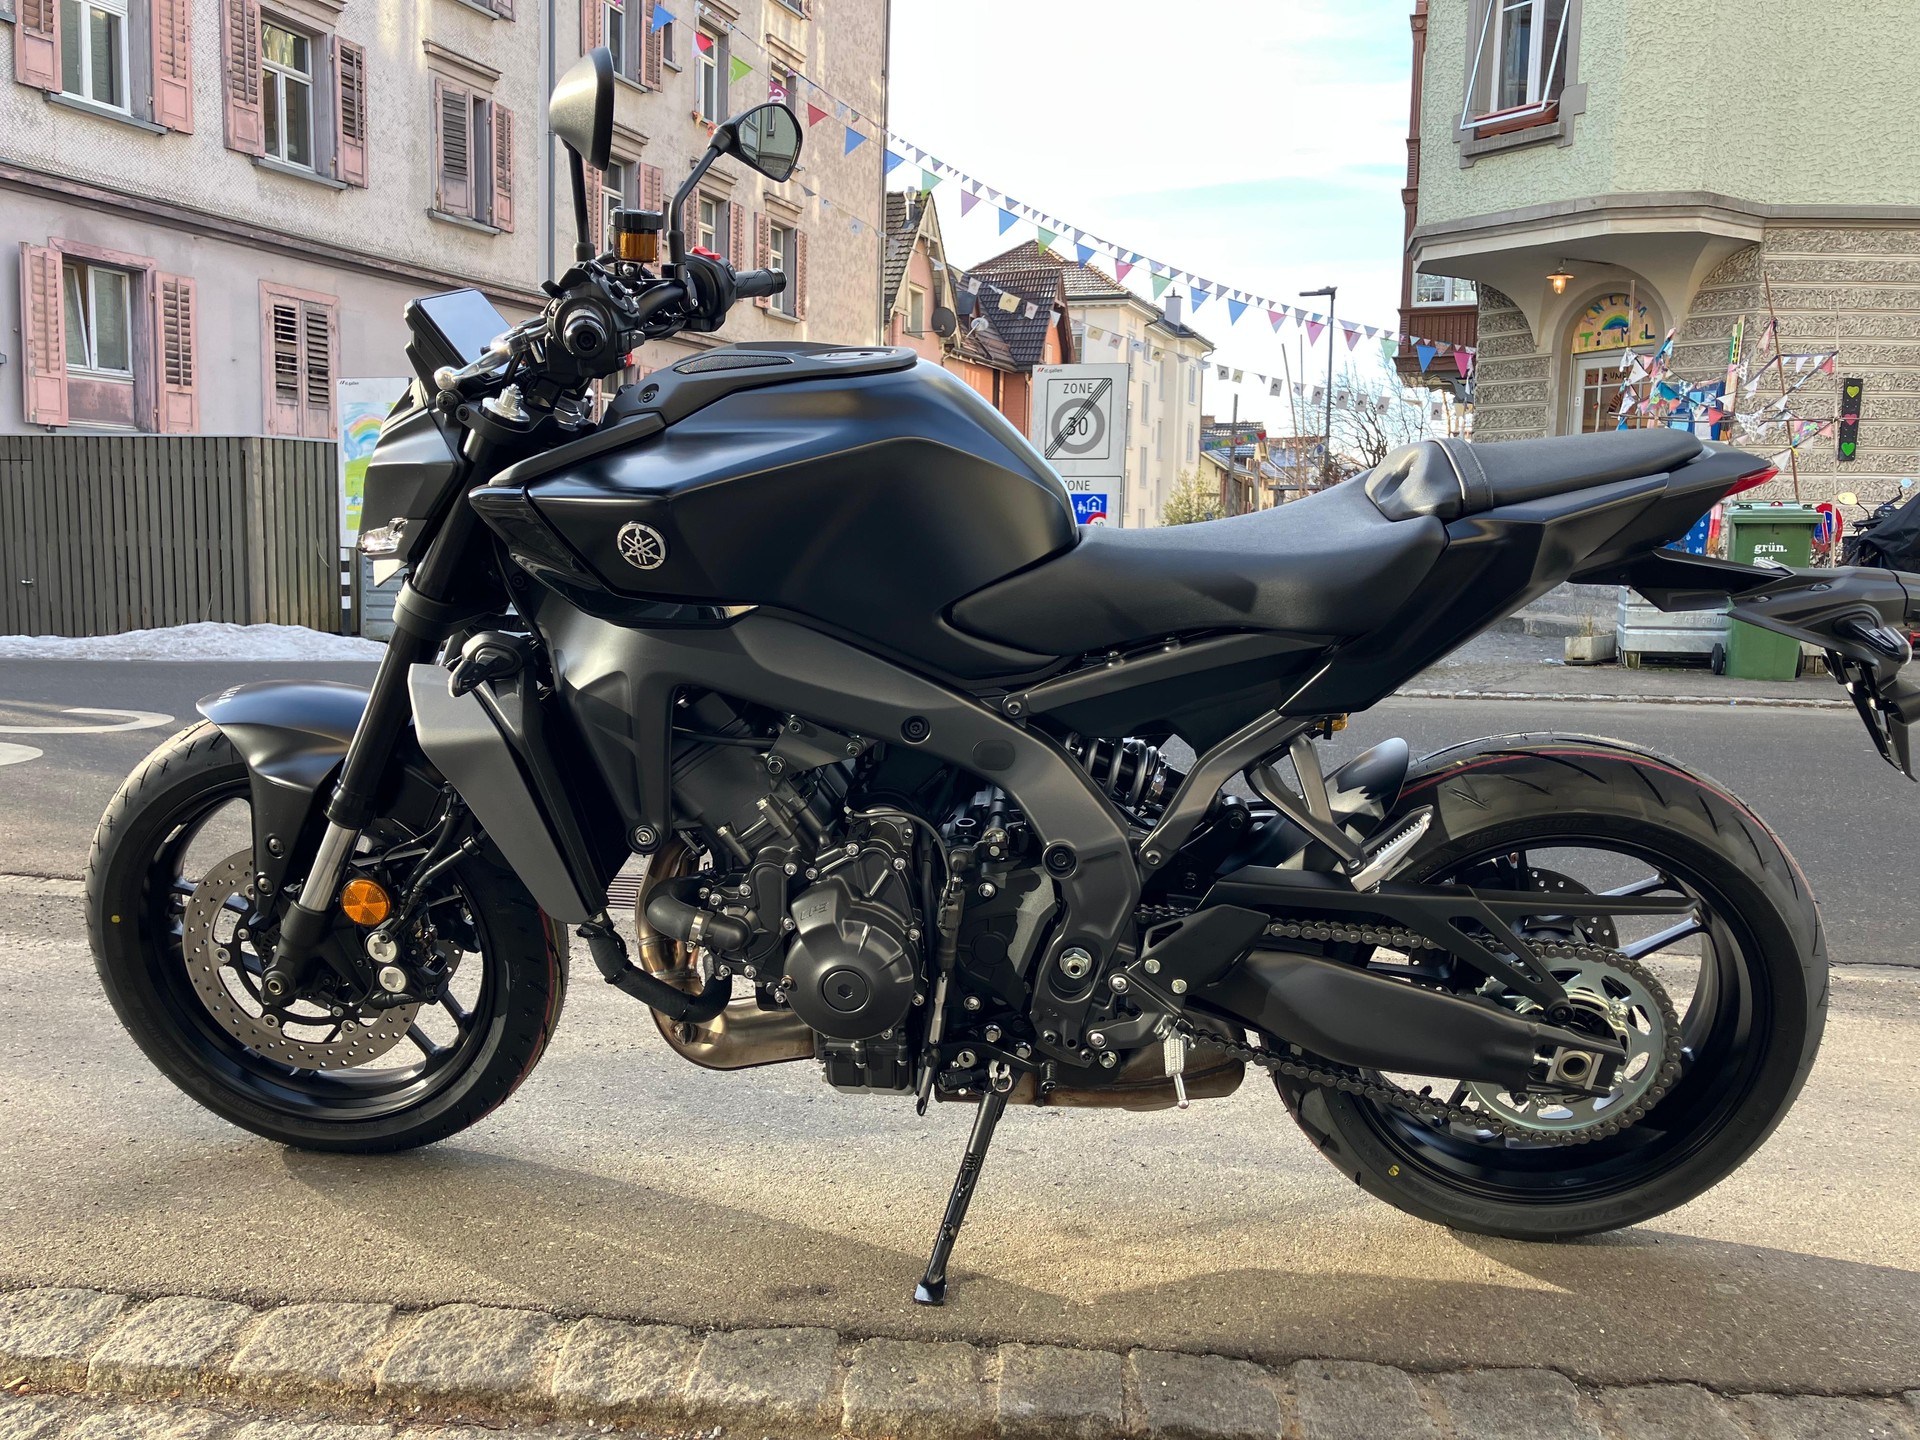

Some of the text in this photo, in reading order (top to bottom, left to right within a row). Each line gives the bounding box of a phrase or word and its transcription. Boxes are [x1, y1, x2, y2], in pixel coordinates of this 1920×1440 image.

[1063, 383, 1093, 394] ZONE
[1067, 416, 1088, 436] 30
[1753, 542, 1788, 554] grün.
